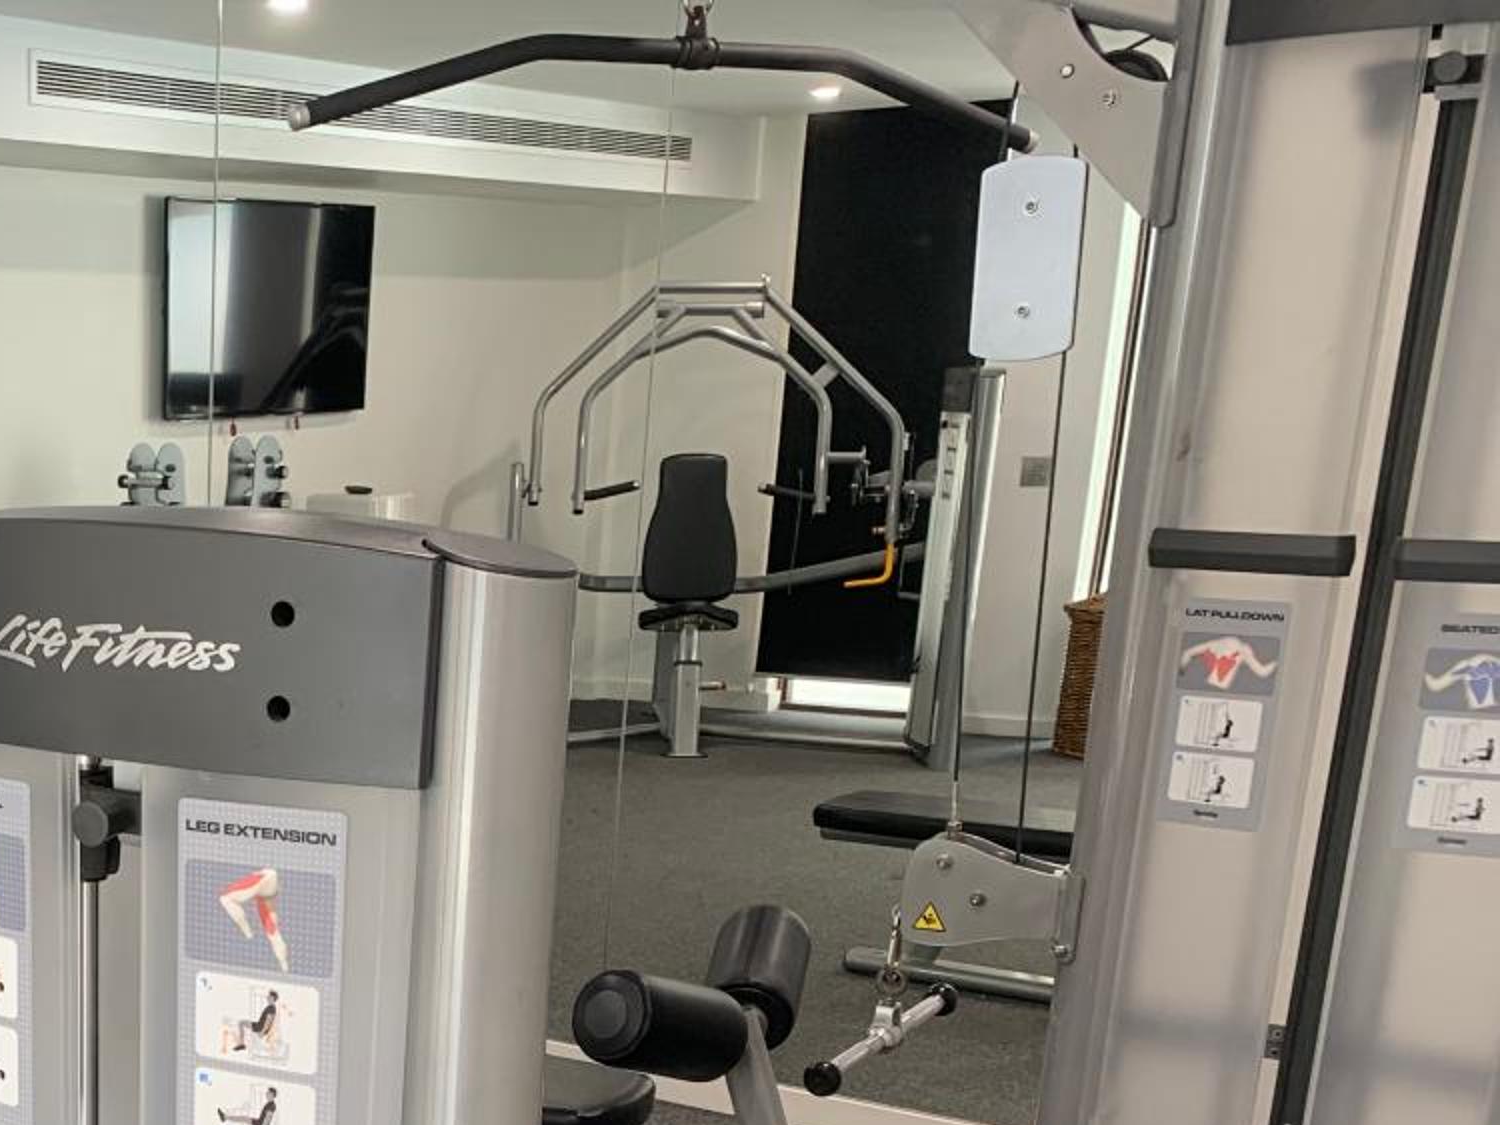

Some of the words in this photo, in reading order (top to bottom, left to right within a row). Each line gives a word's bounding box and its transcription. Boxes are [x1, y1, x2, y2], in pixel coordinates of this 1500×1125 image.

[61, 622, 241, 672] Fitness
[185, 818, 220, 834] LEG
[223, 823, 337, 847] EXTENSION
